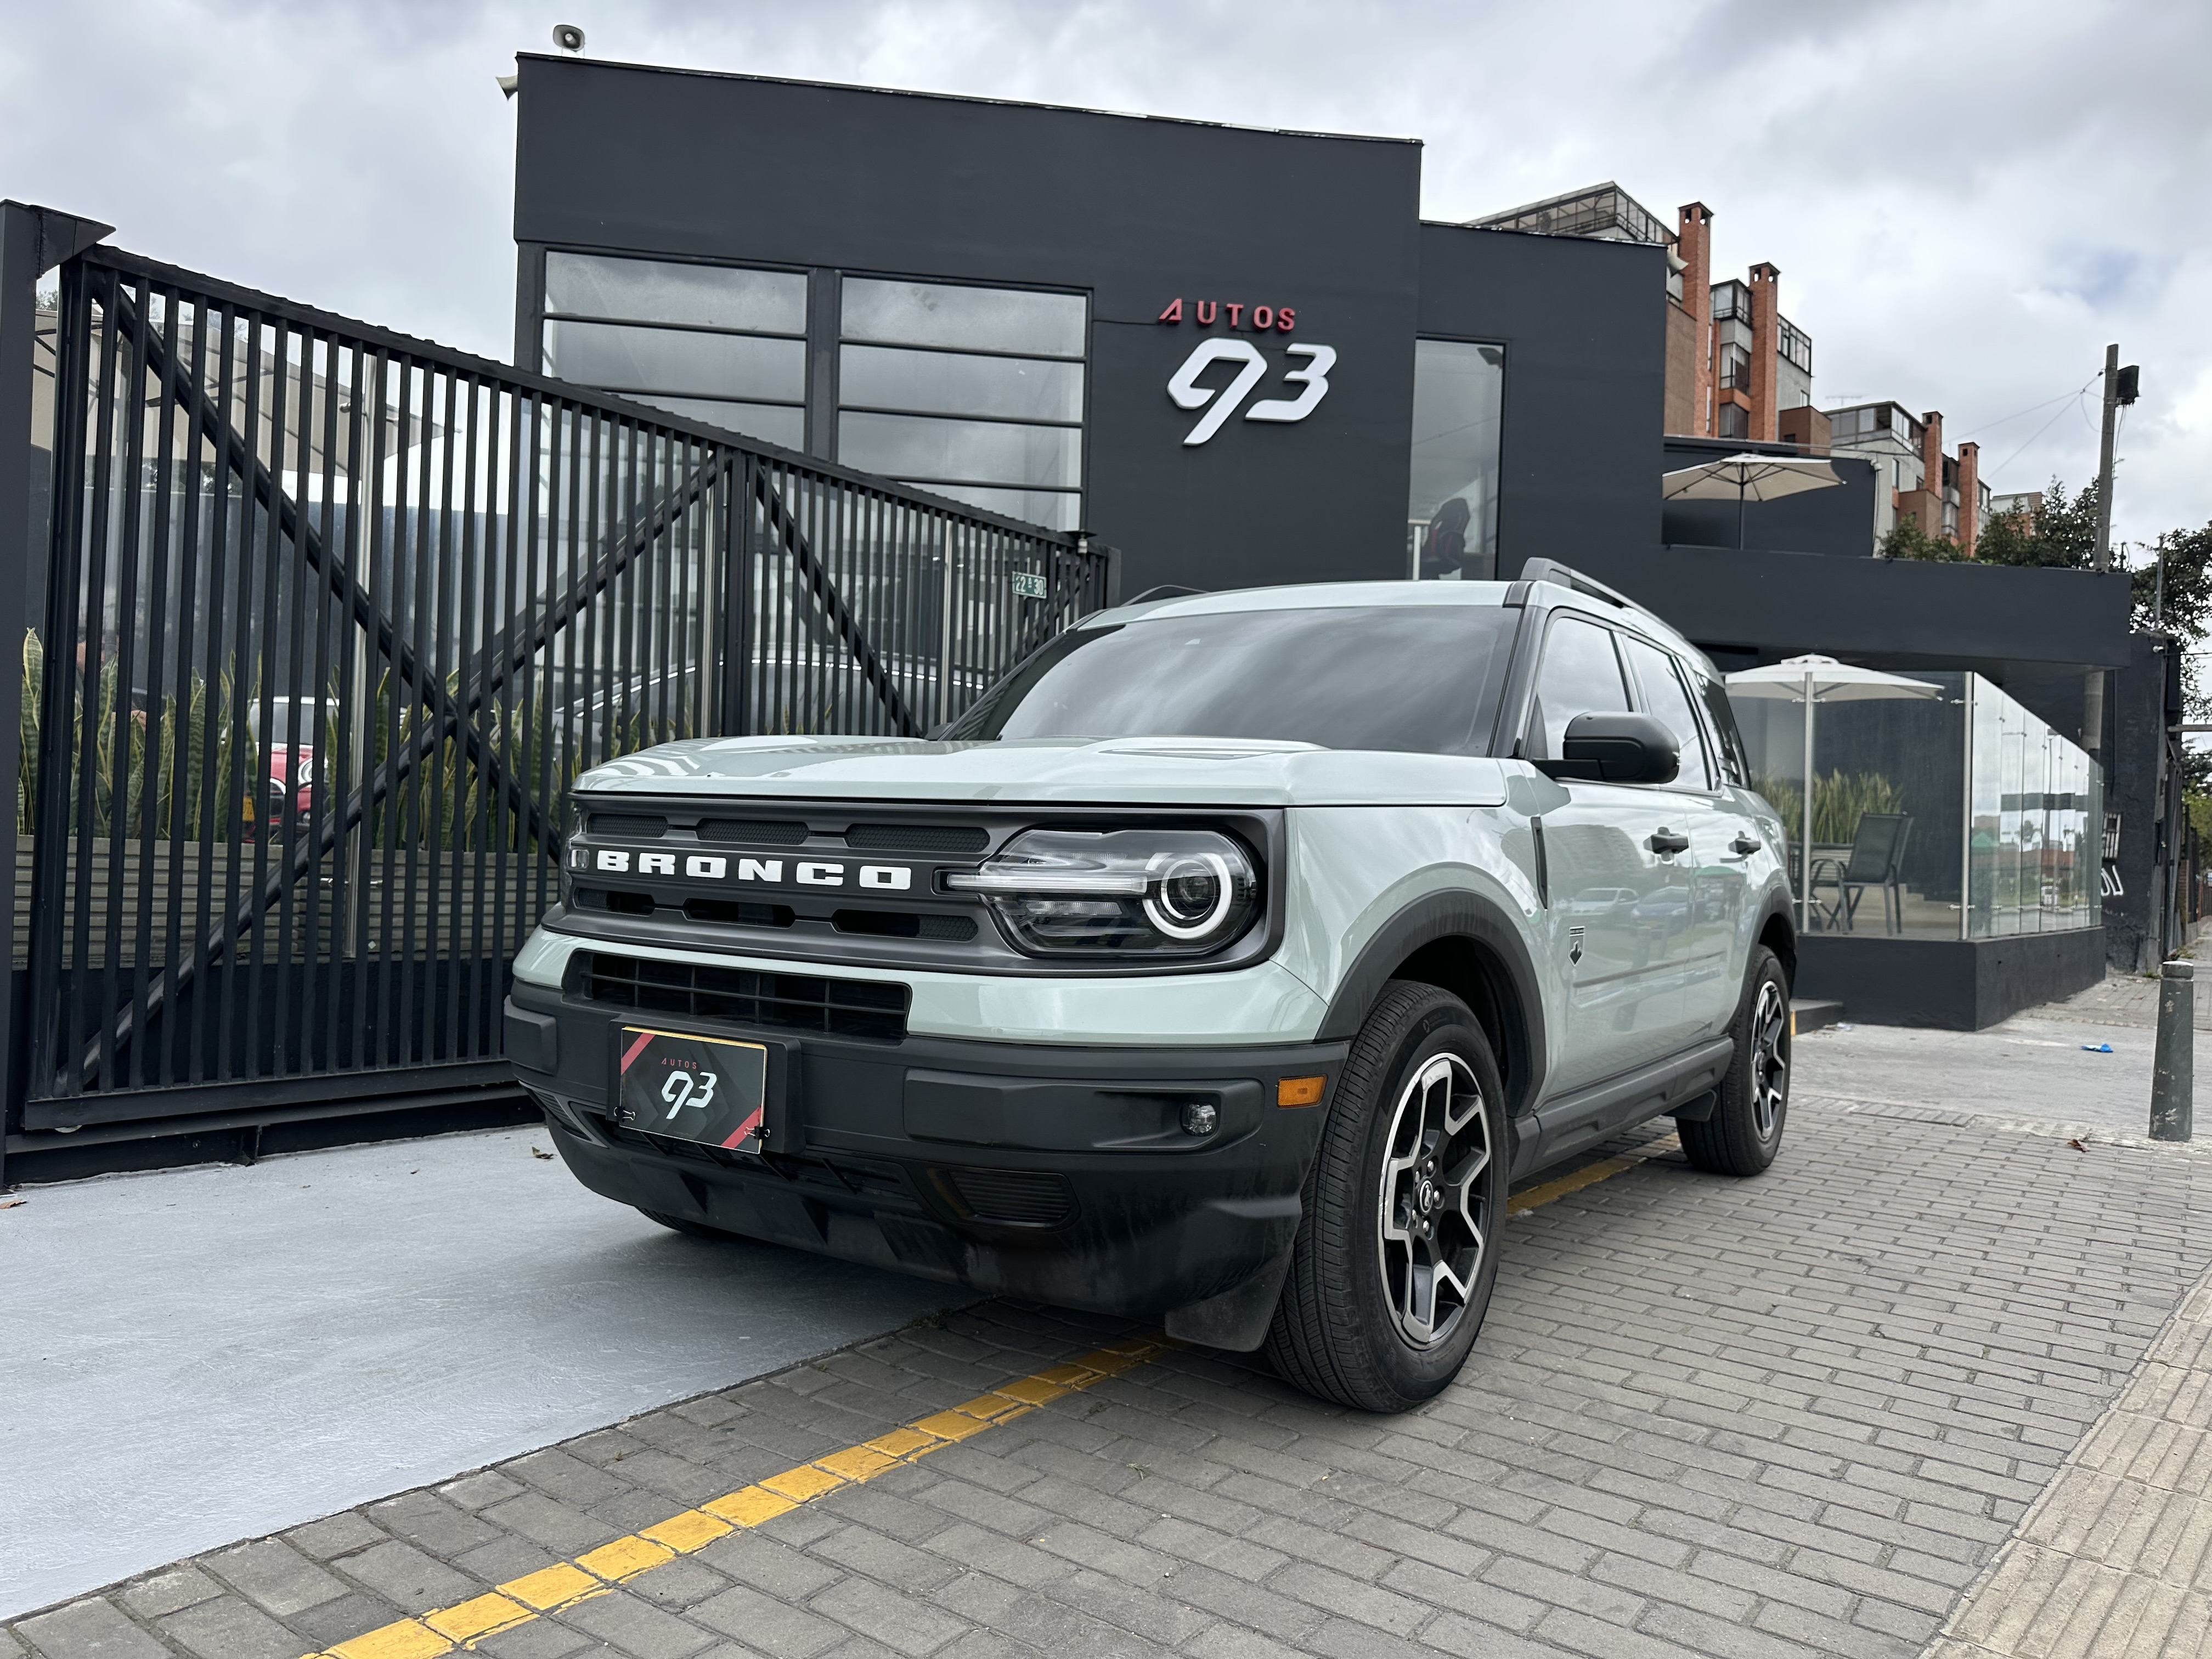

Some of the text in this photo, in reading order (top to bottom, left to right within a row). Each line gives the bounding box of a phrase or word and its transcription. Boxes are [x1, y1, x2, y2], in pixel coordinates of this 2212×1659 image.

[1158, 298, 1296, 332] AUTOS
[1166, 337, 1338, 446] 93
[597, 849, 912, 890] BRONCO
[661, 1057, 697, 1070] AUTOS
[661, 1070, 718, 1120] 93
